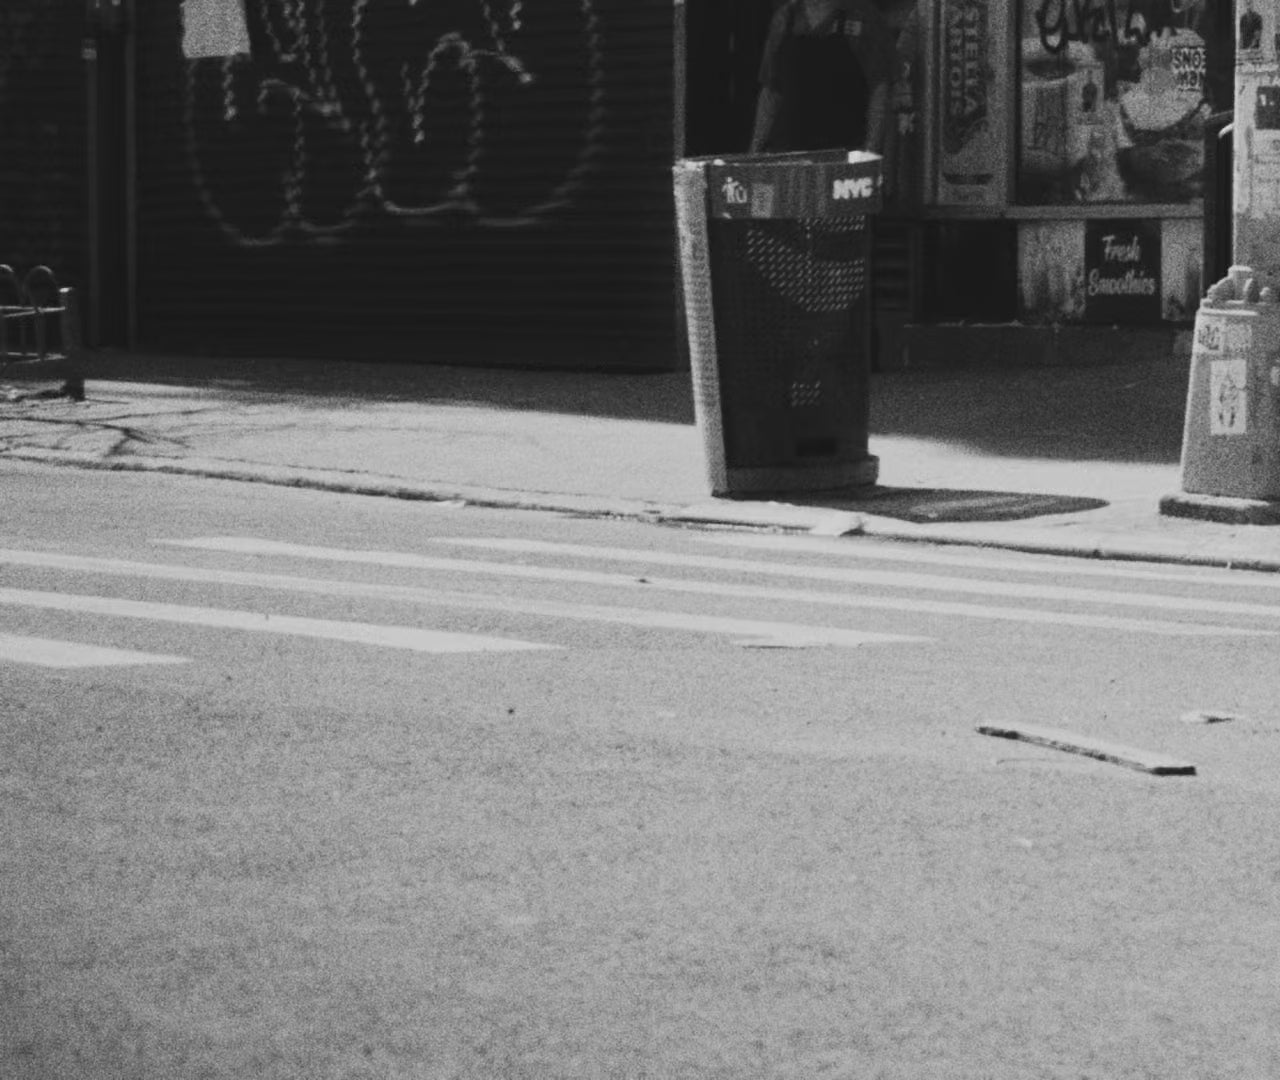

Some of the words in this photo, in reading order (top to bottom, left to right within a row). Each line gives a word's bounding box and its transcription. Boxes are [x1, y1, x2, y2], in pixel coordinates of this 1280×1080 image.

[832, 176, 874, 200] NYC
[1102, 234, 1141, 263] Fresh
[1087, 269, 1156, 297] Smoothies
